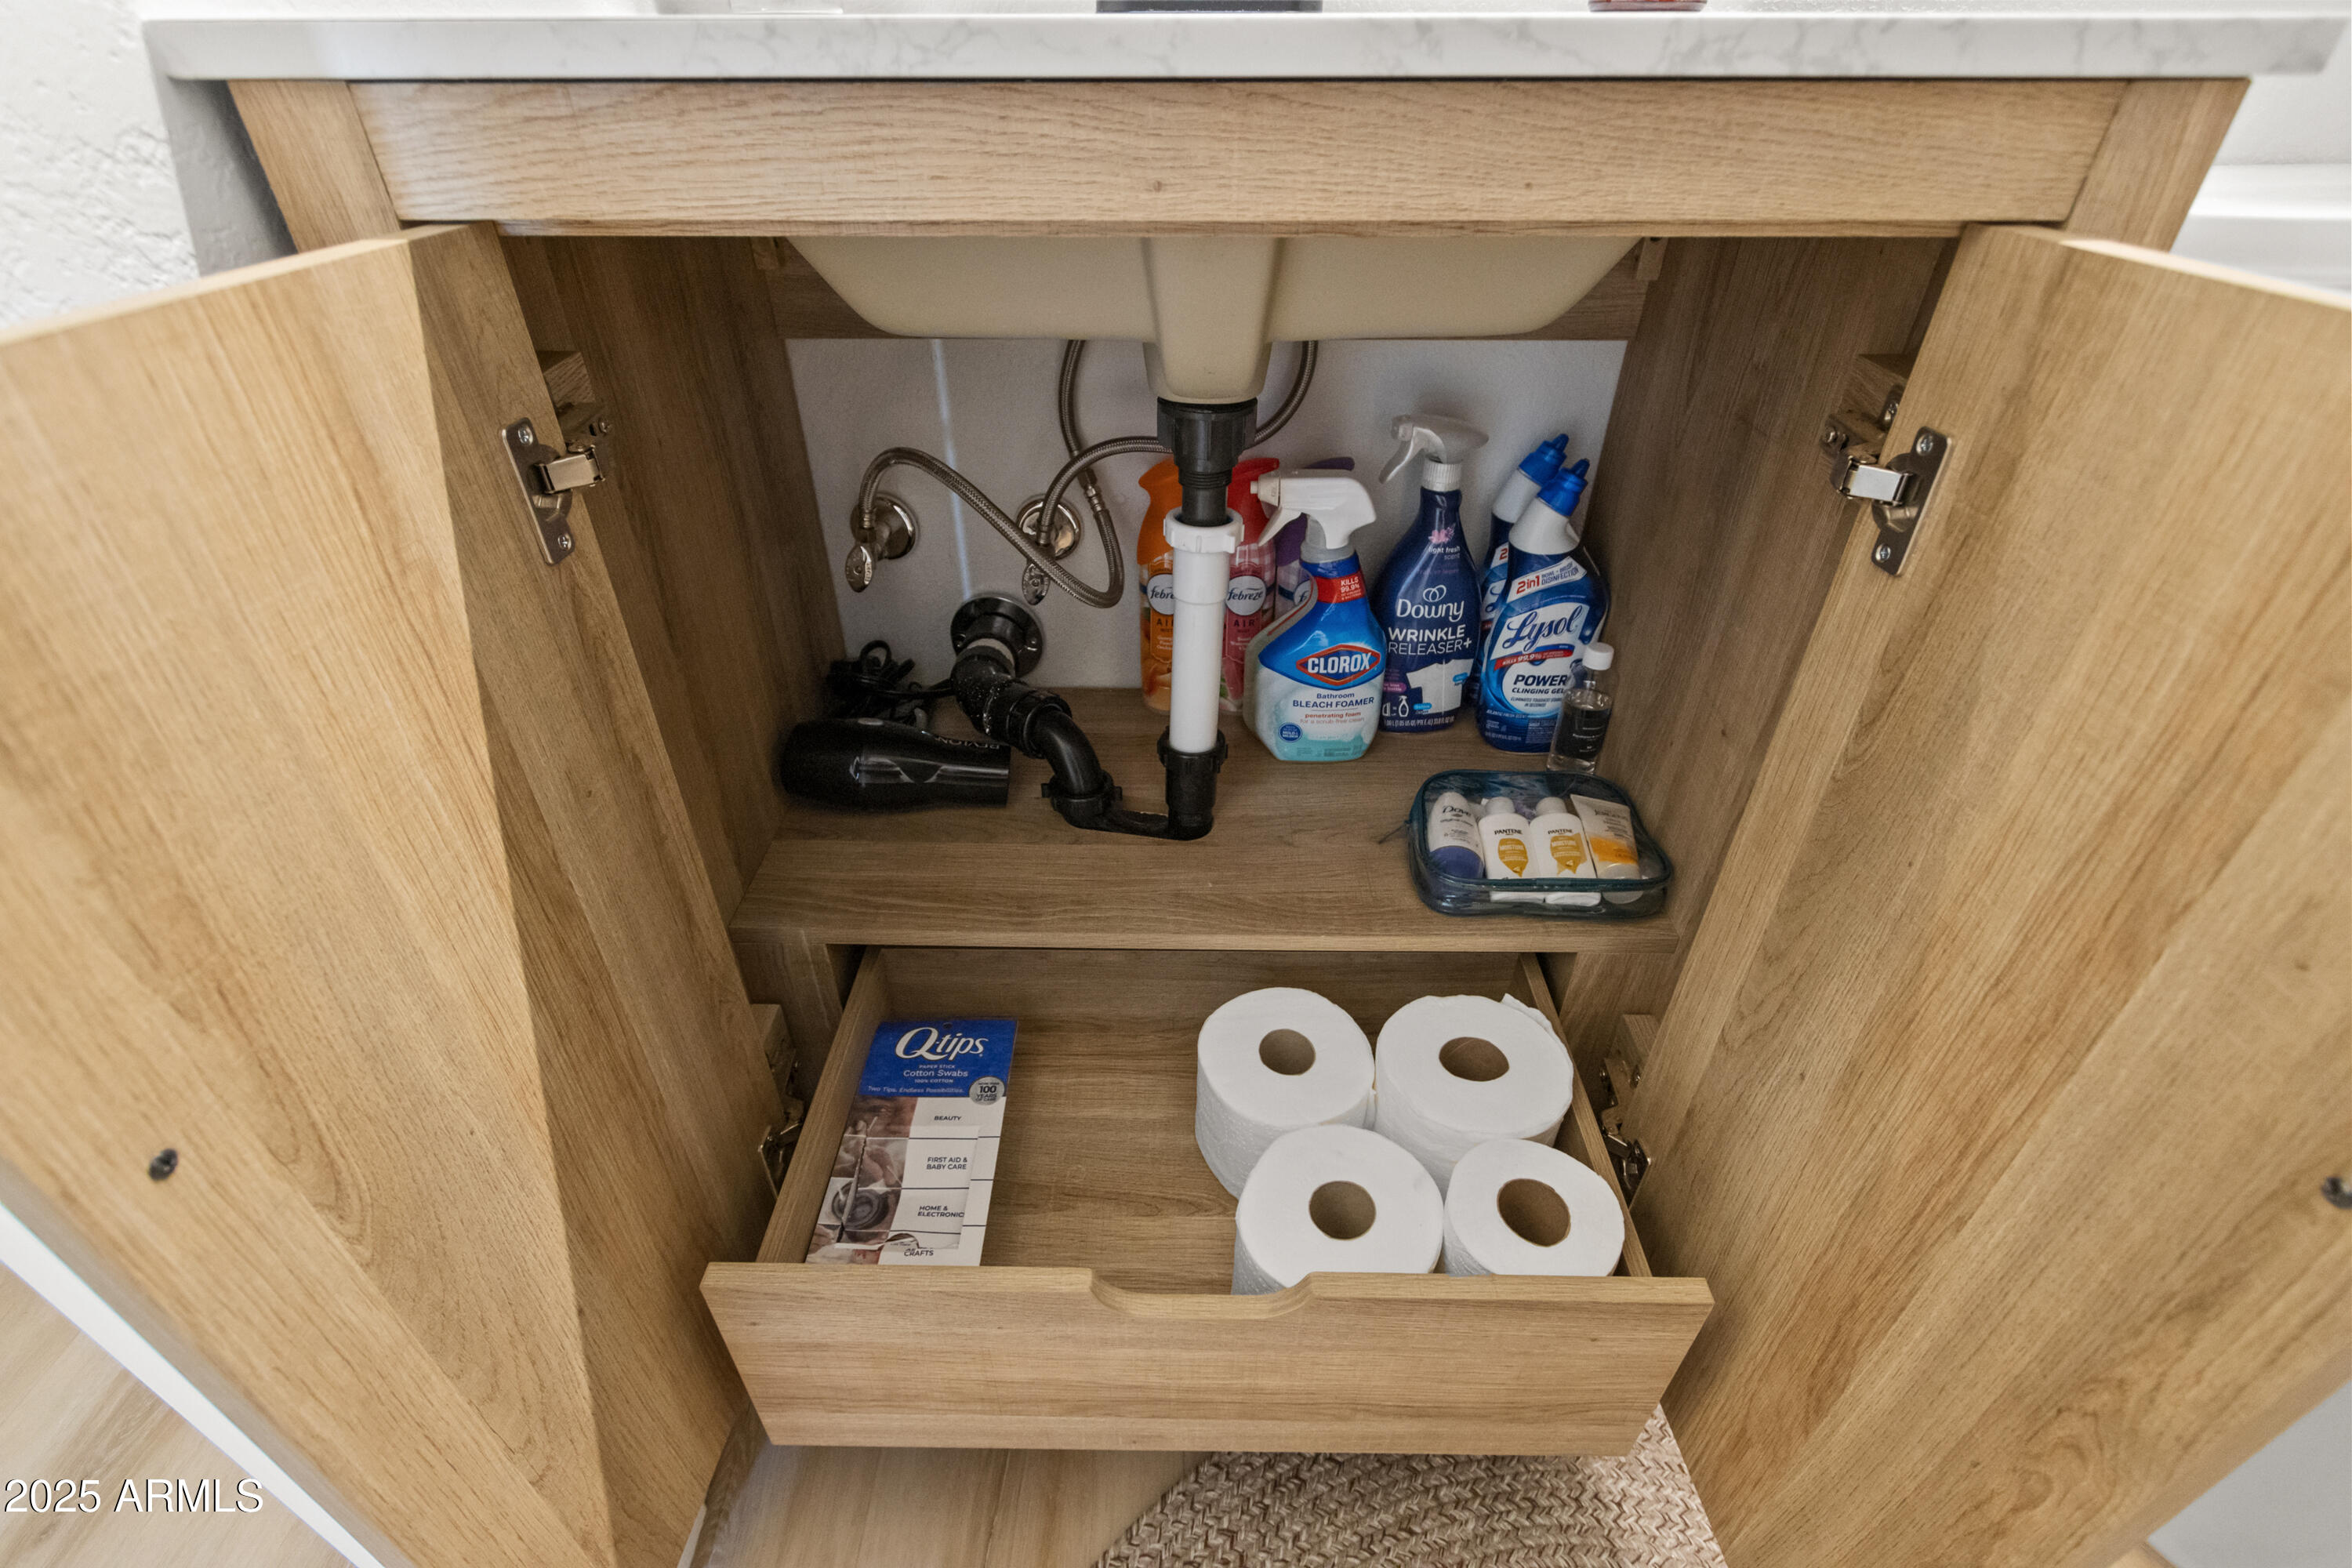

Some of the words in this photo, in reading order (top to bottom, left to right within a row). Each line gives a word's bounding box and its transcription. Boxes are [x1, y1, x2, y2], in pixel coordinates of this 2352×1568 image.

[1341, 576, 1359, 586] KILLS
[1341, 583, 1360, 593] 99.9%
[1516, 575, 1540, 594] 2in1
[1150, 585, 1174, 599] febre
[1227, 587, 1264, 601] febreze
[1396, 598, 1465, 622] Downy
[1388, 624, 1466, 642] WRINKLE
[1502, 605, 1583, 652] Lysol
[1308, 652, 1372, 674] CLOROX
[1513, 674, 1568, 686] POWER
[1292, 699, 1333, 708] BLEACH
[1335, 697, 1374, 708] FOAMER
[1443, 805, 1472, 816] Dove
[895, 1026, 989, 1061] Q-tips
[980, 1085, 997, 1094] 100
